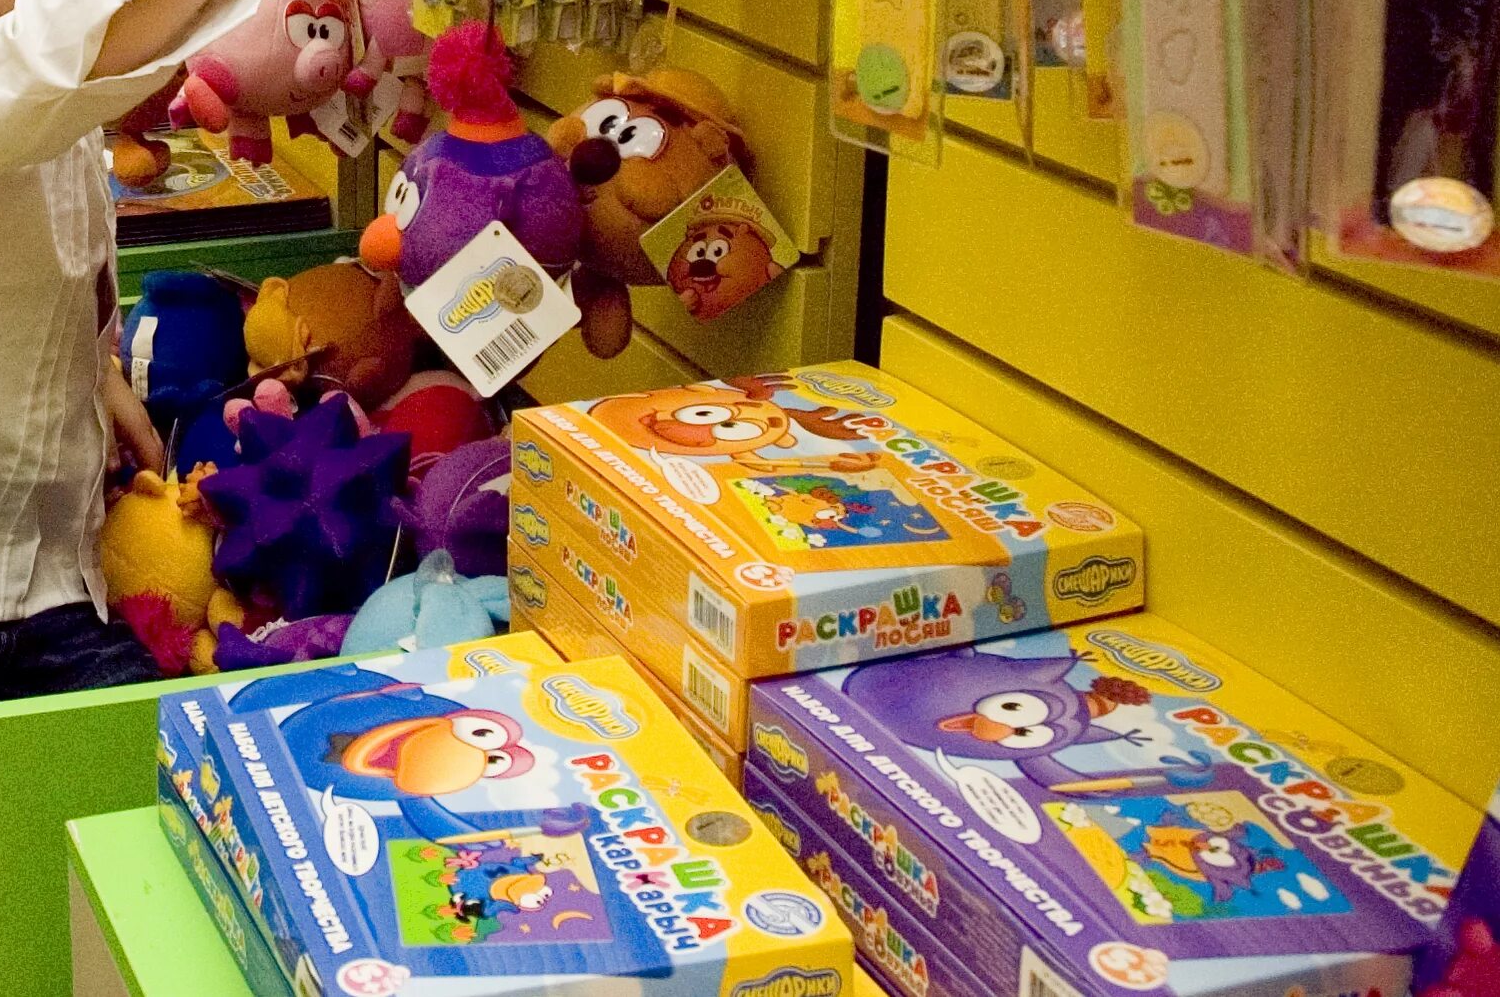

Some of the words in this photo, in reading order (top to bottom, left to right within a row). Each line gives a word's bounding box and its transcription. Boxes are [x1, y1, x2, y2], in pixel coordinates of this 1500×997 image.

[852, 415, 1044, 538] РАСКРАШКА
[777, 584, 963, 649] РАСКРАШКА
[1094, 632, 1217, 689] СМЕШАРИКИ
[571, 753, 737, 941] РАСКРАШКА
[780, 685, 841, 735] НАБОР
[829, 723, 875, 756] ДЛЯ
[864, 753, 964, 829] ДЕТСКОГО
[958, 826, 1086, 938] ТВОРЧЕСТВА
